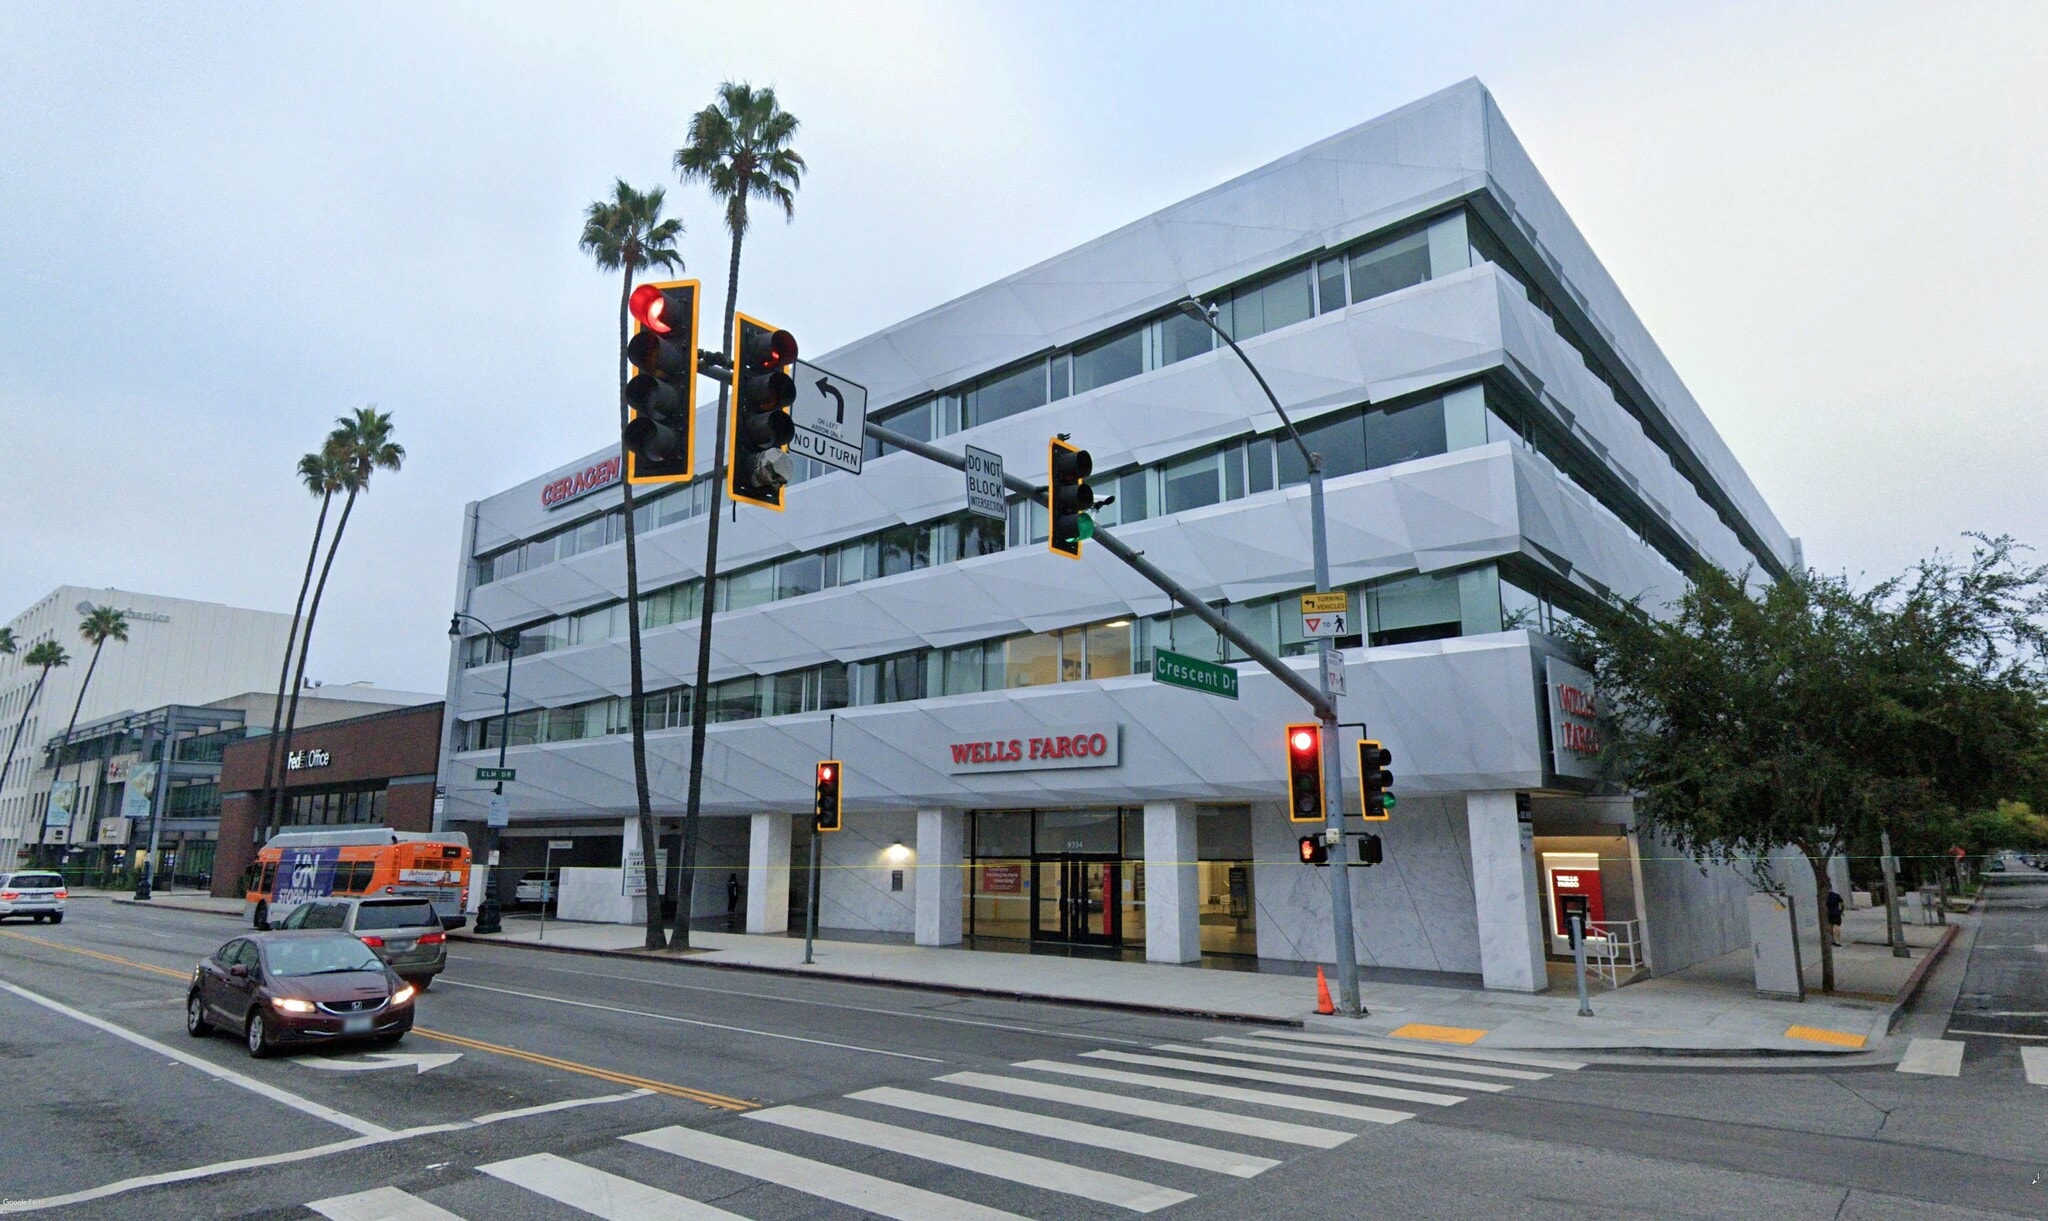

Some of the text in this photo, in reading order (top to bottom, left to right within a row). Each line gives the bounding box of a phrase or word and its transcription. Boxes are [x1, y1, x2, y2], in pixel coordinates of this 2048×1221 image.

[794, 432, 858, 467] NO U TURN
[968, 454, 1001, 478] DO NOT
[541, 455, 621, 506] CERAGEM
[969, 476, 1003, 499] BLOCK
[970, 495, 1005, 514] INTERSECTION
[1316, 603, 1345, 611] VEHICLES
[1317, 595, 1344, 603] TURNING
[1157, 656, 1236, 691] Crescent Dr
[308, 748, 330, 767] Office
[950, 732, 1108, 765] WELLS FARGO
